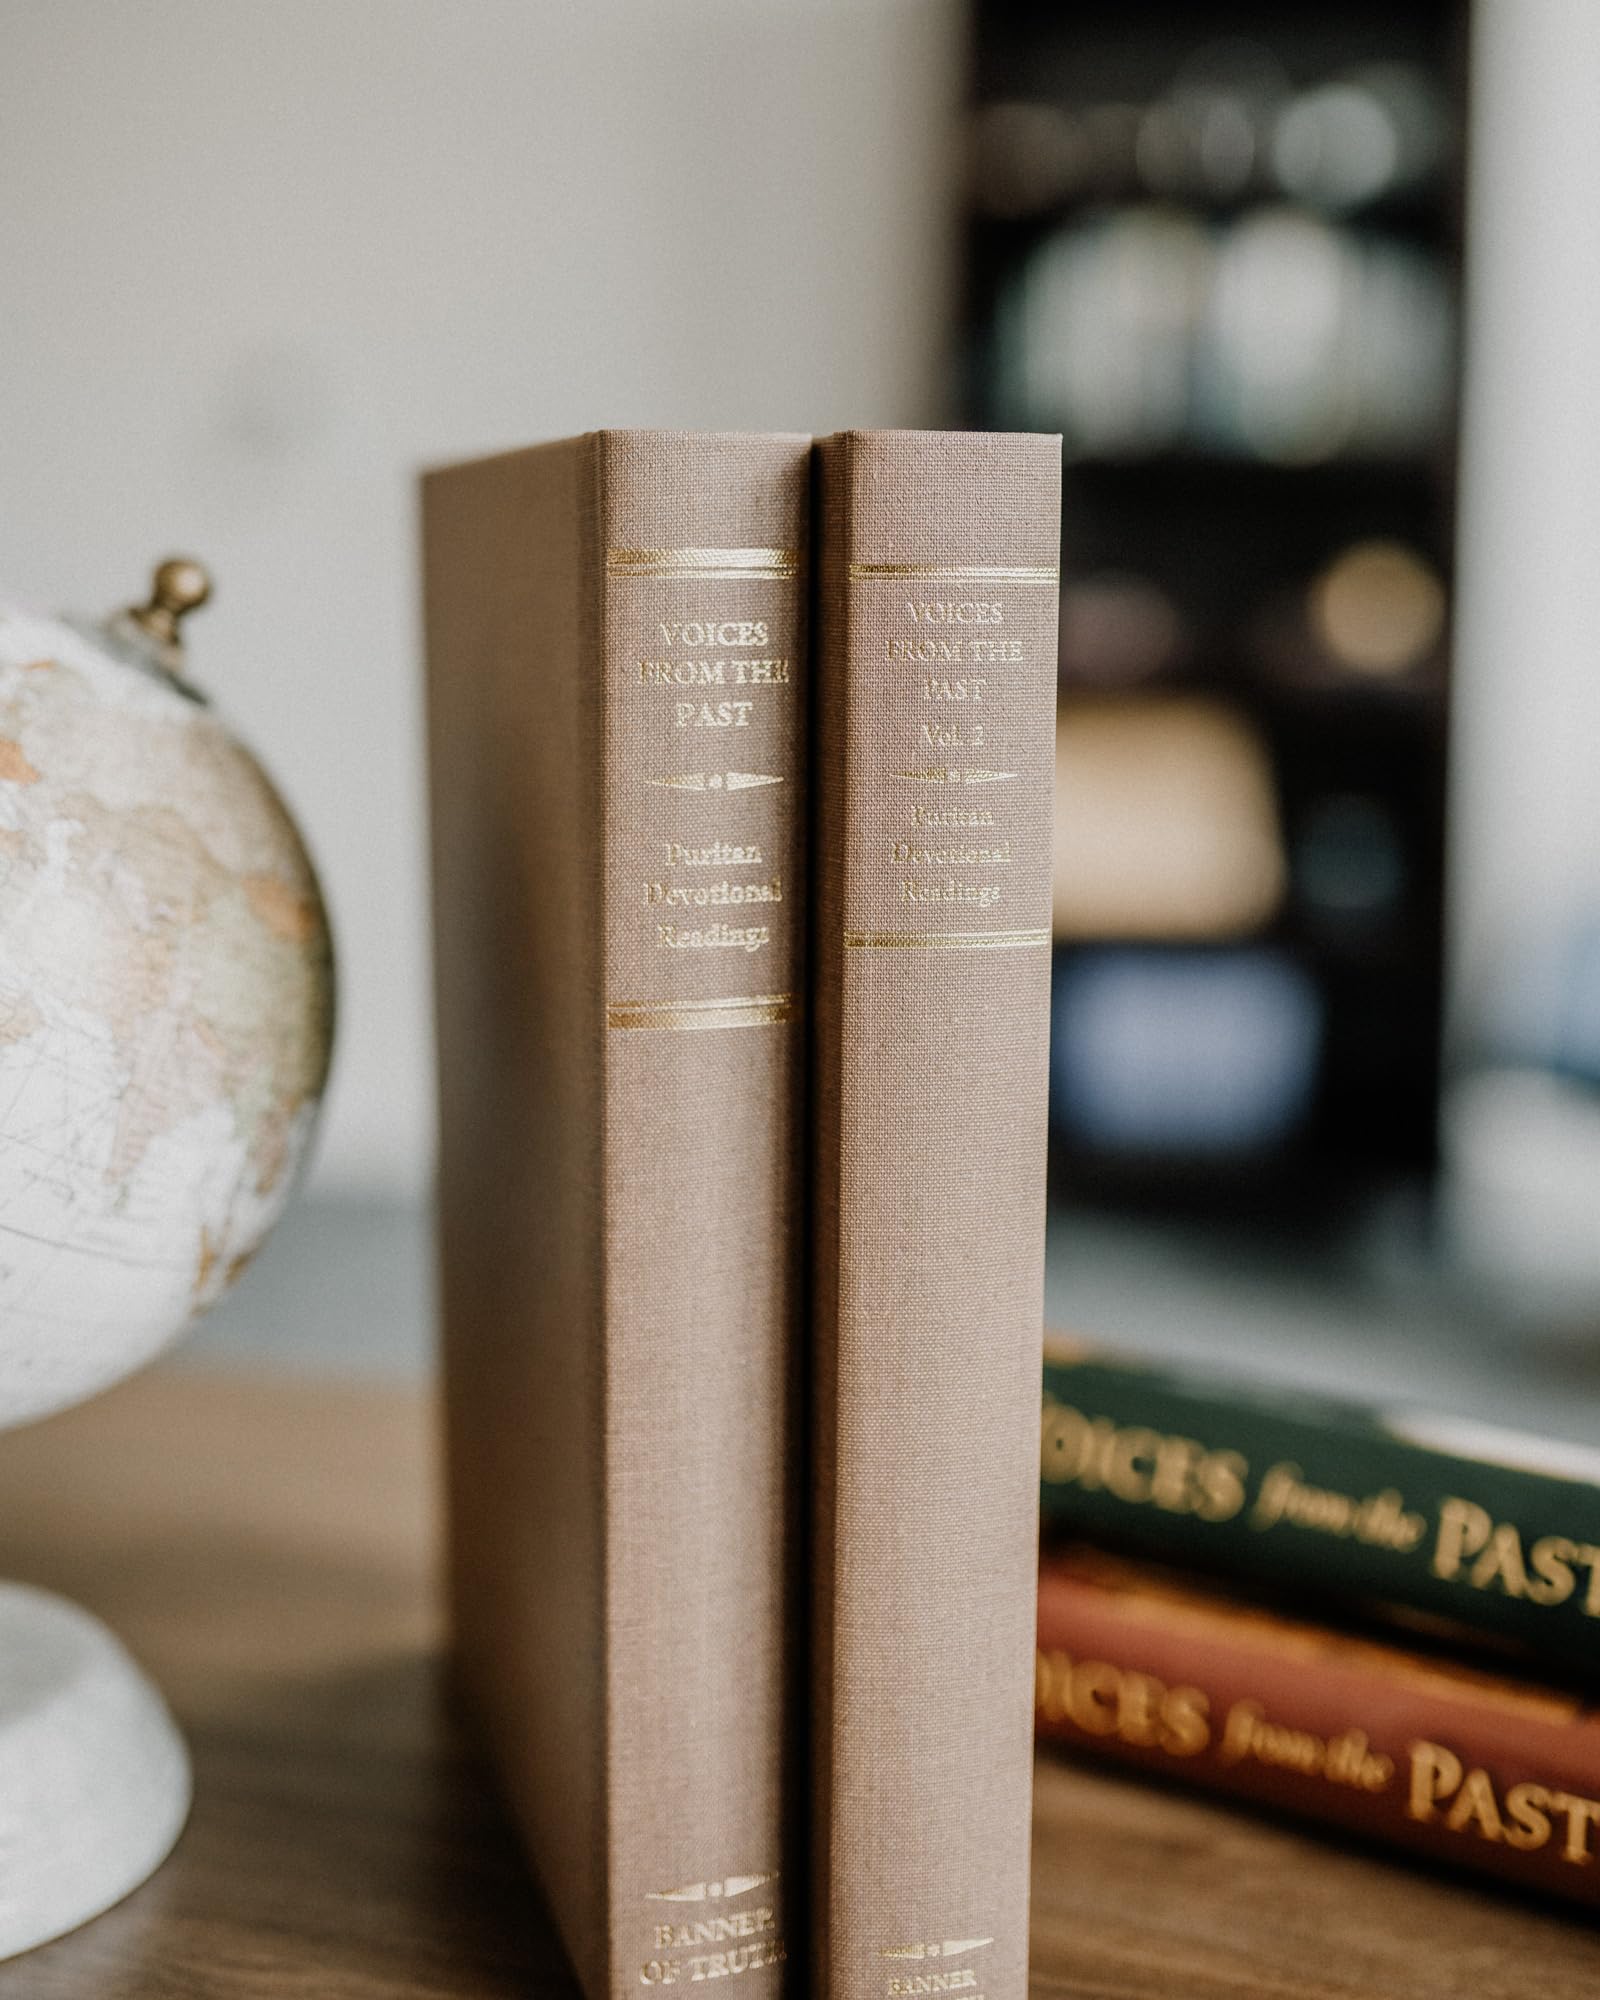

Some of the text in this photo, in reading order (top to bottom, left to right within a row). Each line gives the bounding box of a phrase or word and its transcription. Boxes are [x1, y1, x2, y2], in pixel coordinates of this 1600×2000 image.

[908, 601, 1003, 624] VOICES
[659, 621, 769, 647] VOICES
[884, 640, 1024, 662] FROM THE
[637, 657, 790, 685] FROM THE
[923, 678, 988, 700] PAST
[676, 701, 753, 727] PAST
[972, 724, 985, 747] 2
[911, 805, 995, 827] Puritan
[664, 842, 763, 866] Puritan
[890, 841, 1012, 865] Devotional
[643, 874, 784, 906] Devotional
[899, 880, 1002, 908] Readings
[656, 923, 770, 953] Readings
[1041, 1390, 1248, 1523] OICES
[1432, 1495, 1600, 1618] PAST
[1034, 1648, 1211, 1757] ICES
[1406, 1737, 1600, 1865] PAST
[640, 1959, 681, 1985] OF
[887, 1968, 978, 1995] BANNER
